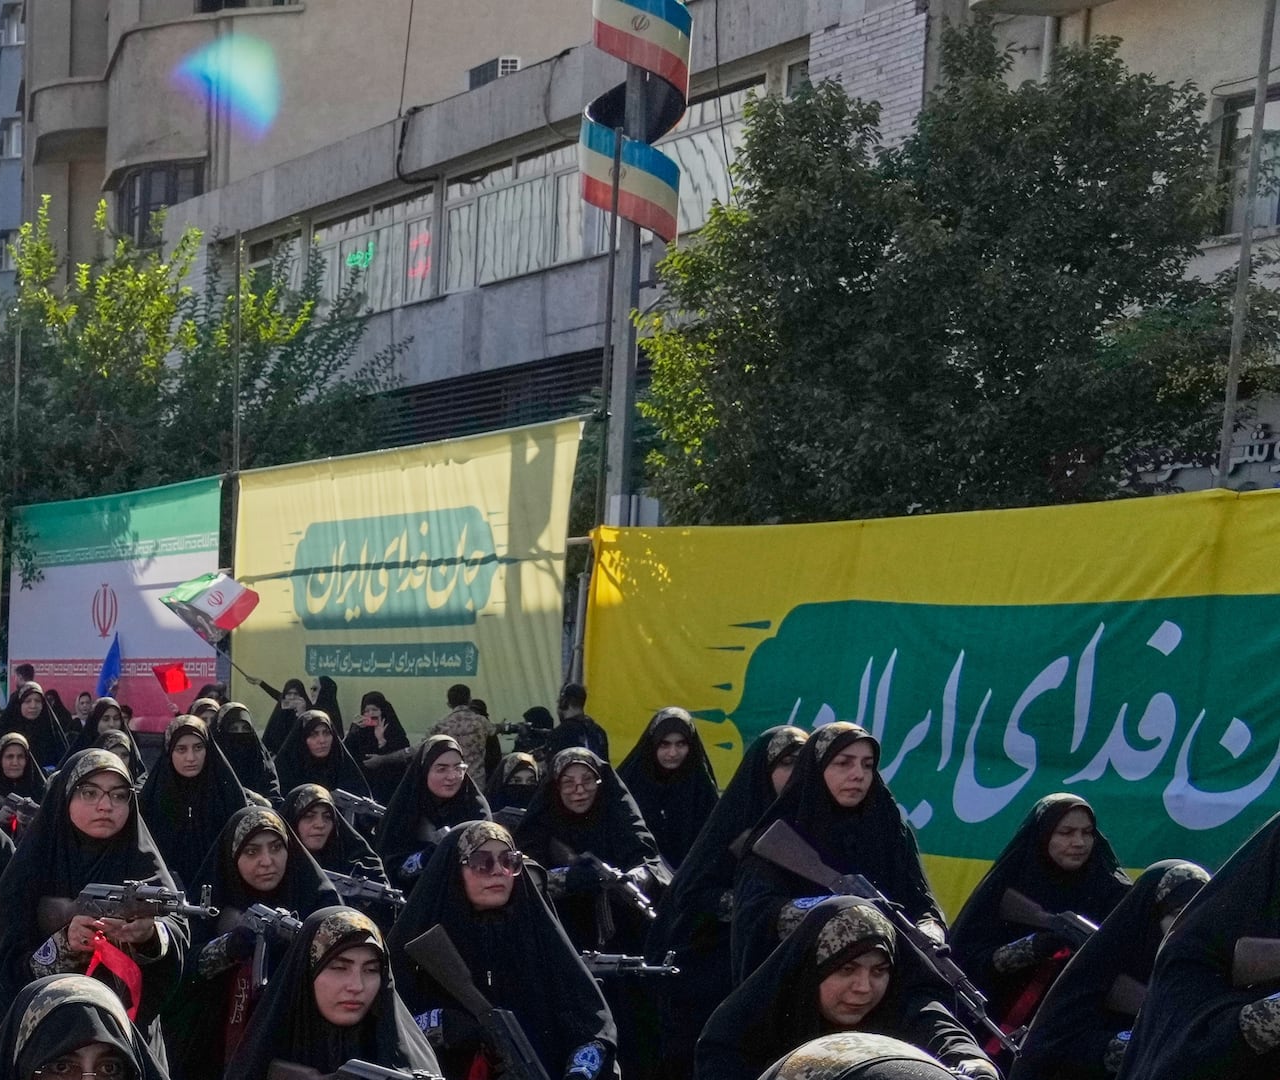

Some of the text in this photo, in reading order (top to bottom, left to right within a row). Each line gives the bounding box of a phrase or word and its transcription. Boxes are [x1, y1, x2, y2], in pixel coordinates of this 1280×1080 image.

[306, 521, 485, 622] جان فدای ایران
[319, 649, 340, 672] آینده
[395, 651, 415, 673] برای
[414, 653, 432, 676] هم
[432, 650, 440, 672] با
[440, 652, 461, 668] همه
[953, 620, 1183, 824] فدای
